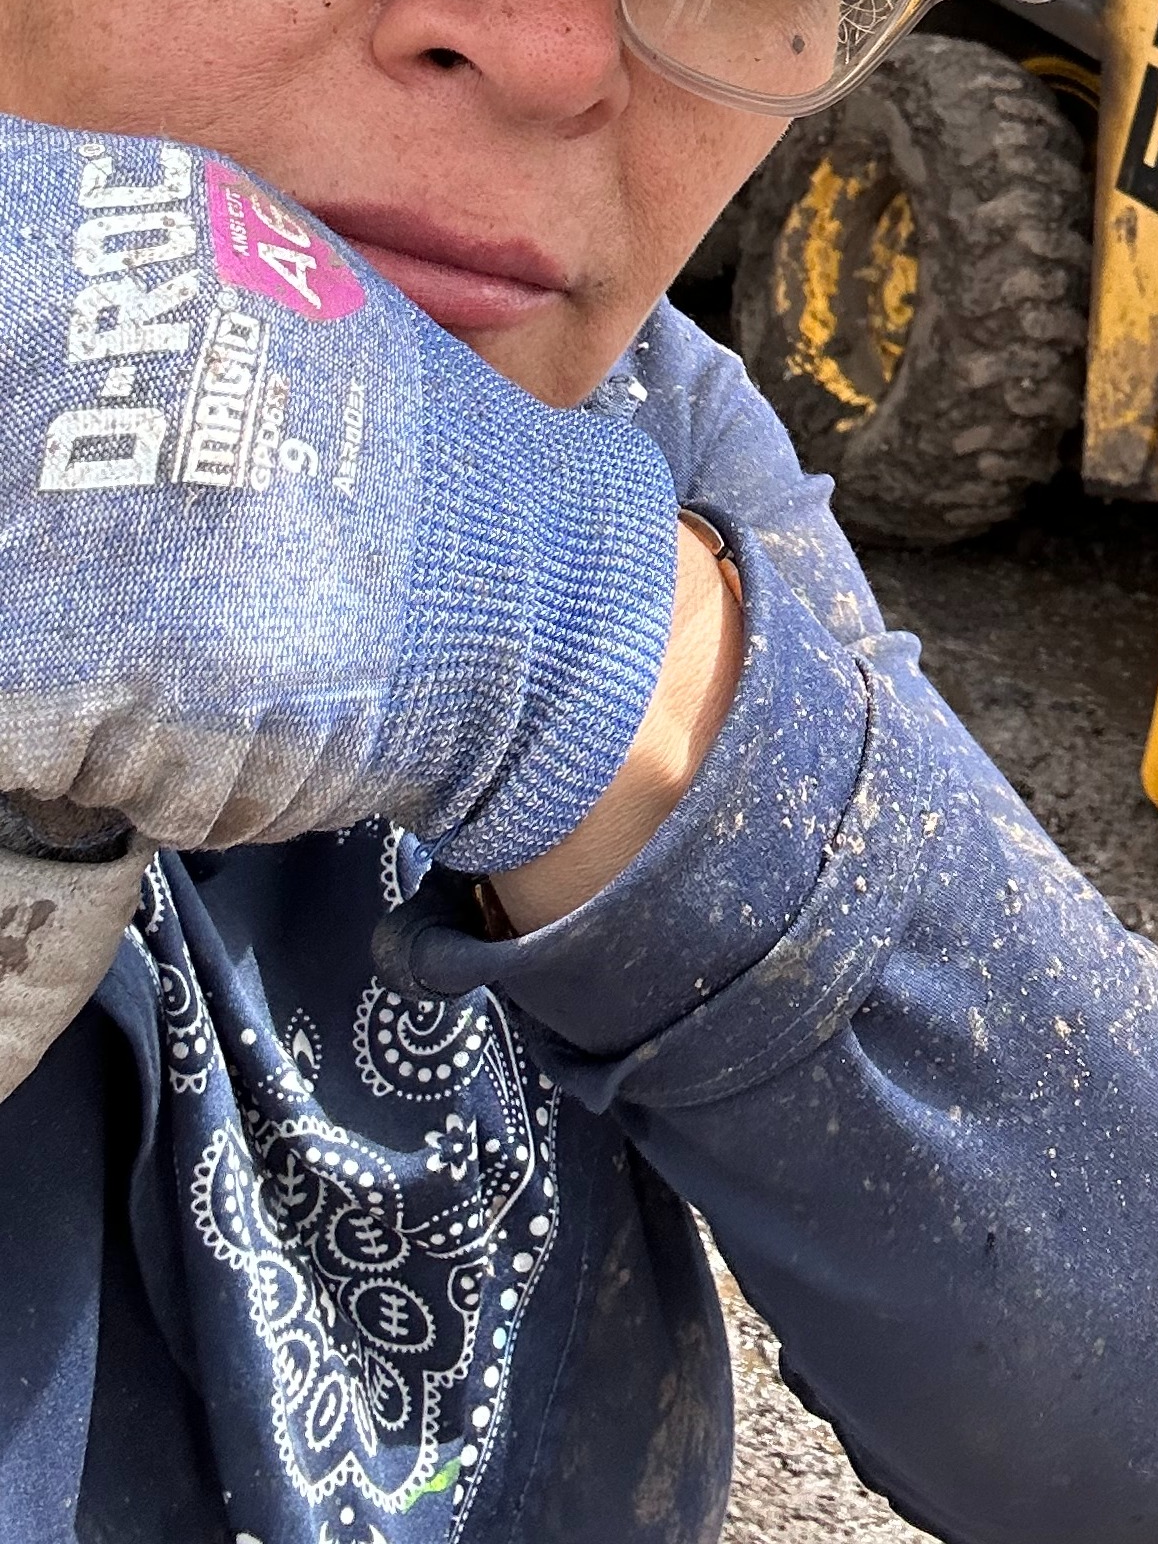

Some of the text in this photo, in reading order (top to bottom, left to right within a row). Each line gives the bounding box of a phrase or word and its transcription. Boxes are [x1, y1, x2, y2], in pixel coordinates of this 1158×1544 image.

[229, 215, 250, 257] ANSI
[37, 146, 200, 491] D-ROC
[183, 312, 261, 488] MAGID
[279, 438, 319, 478] 9
